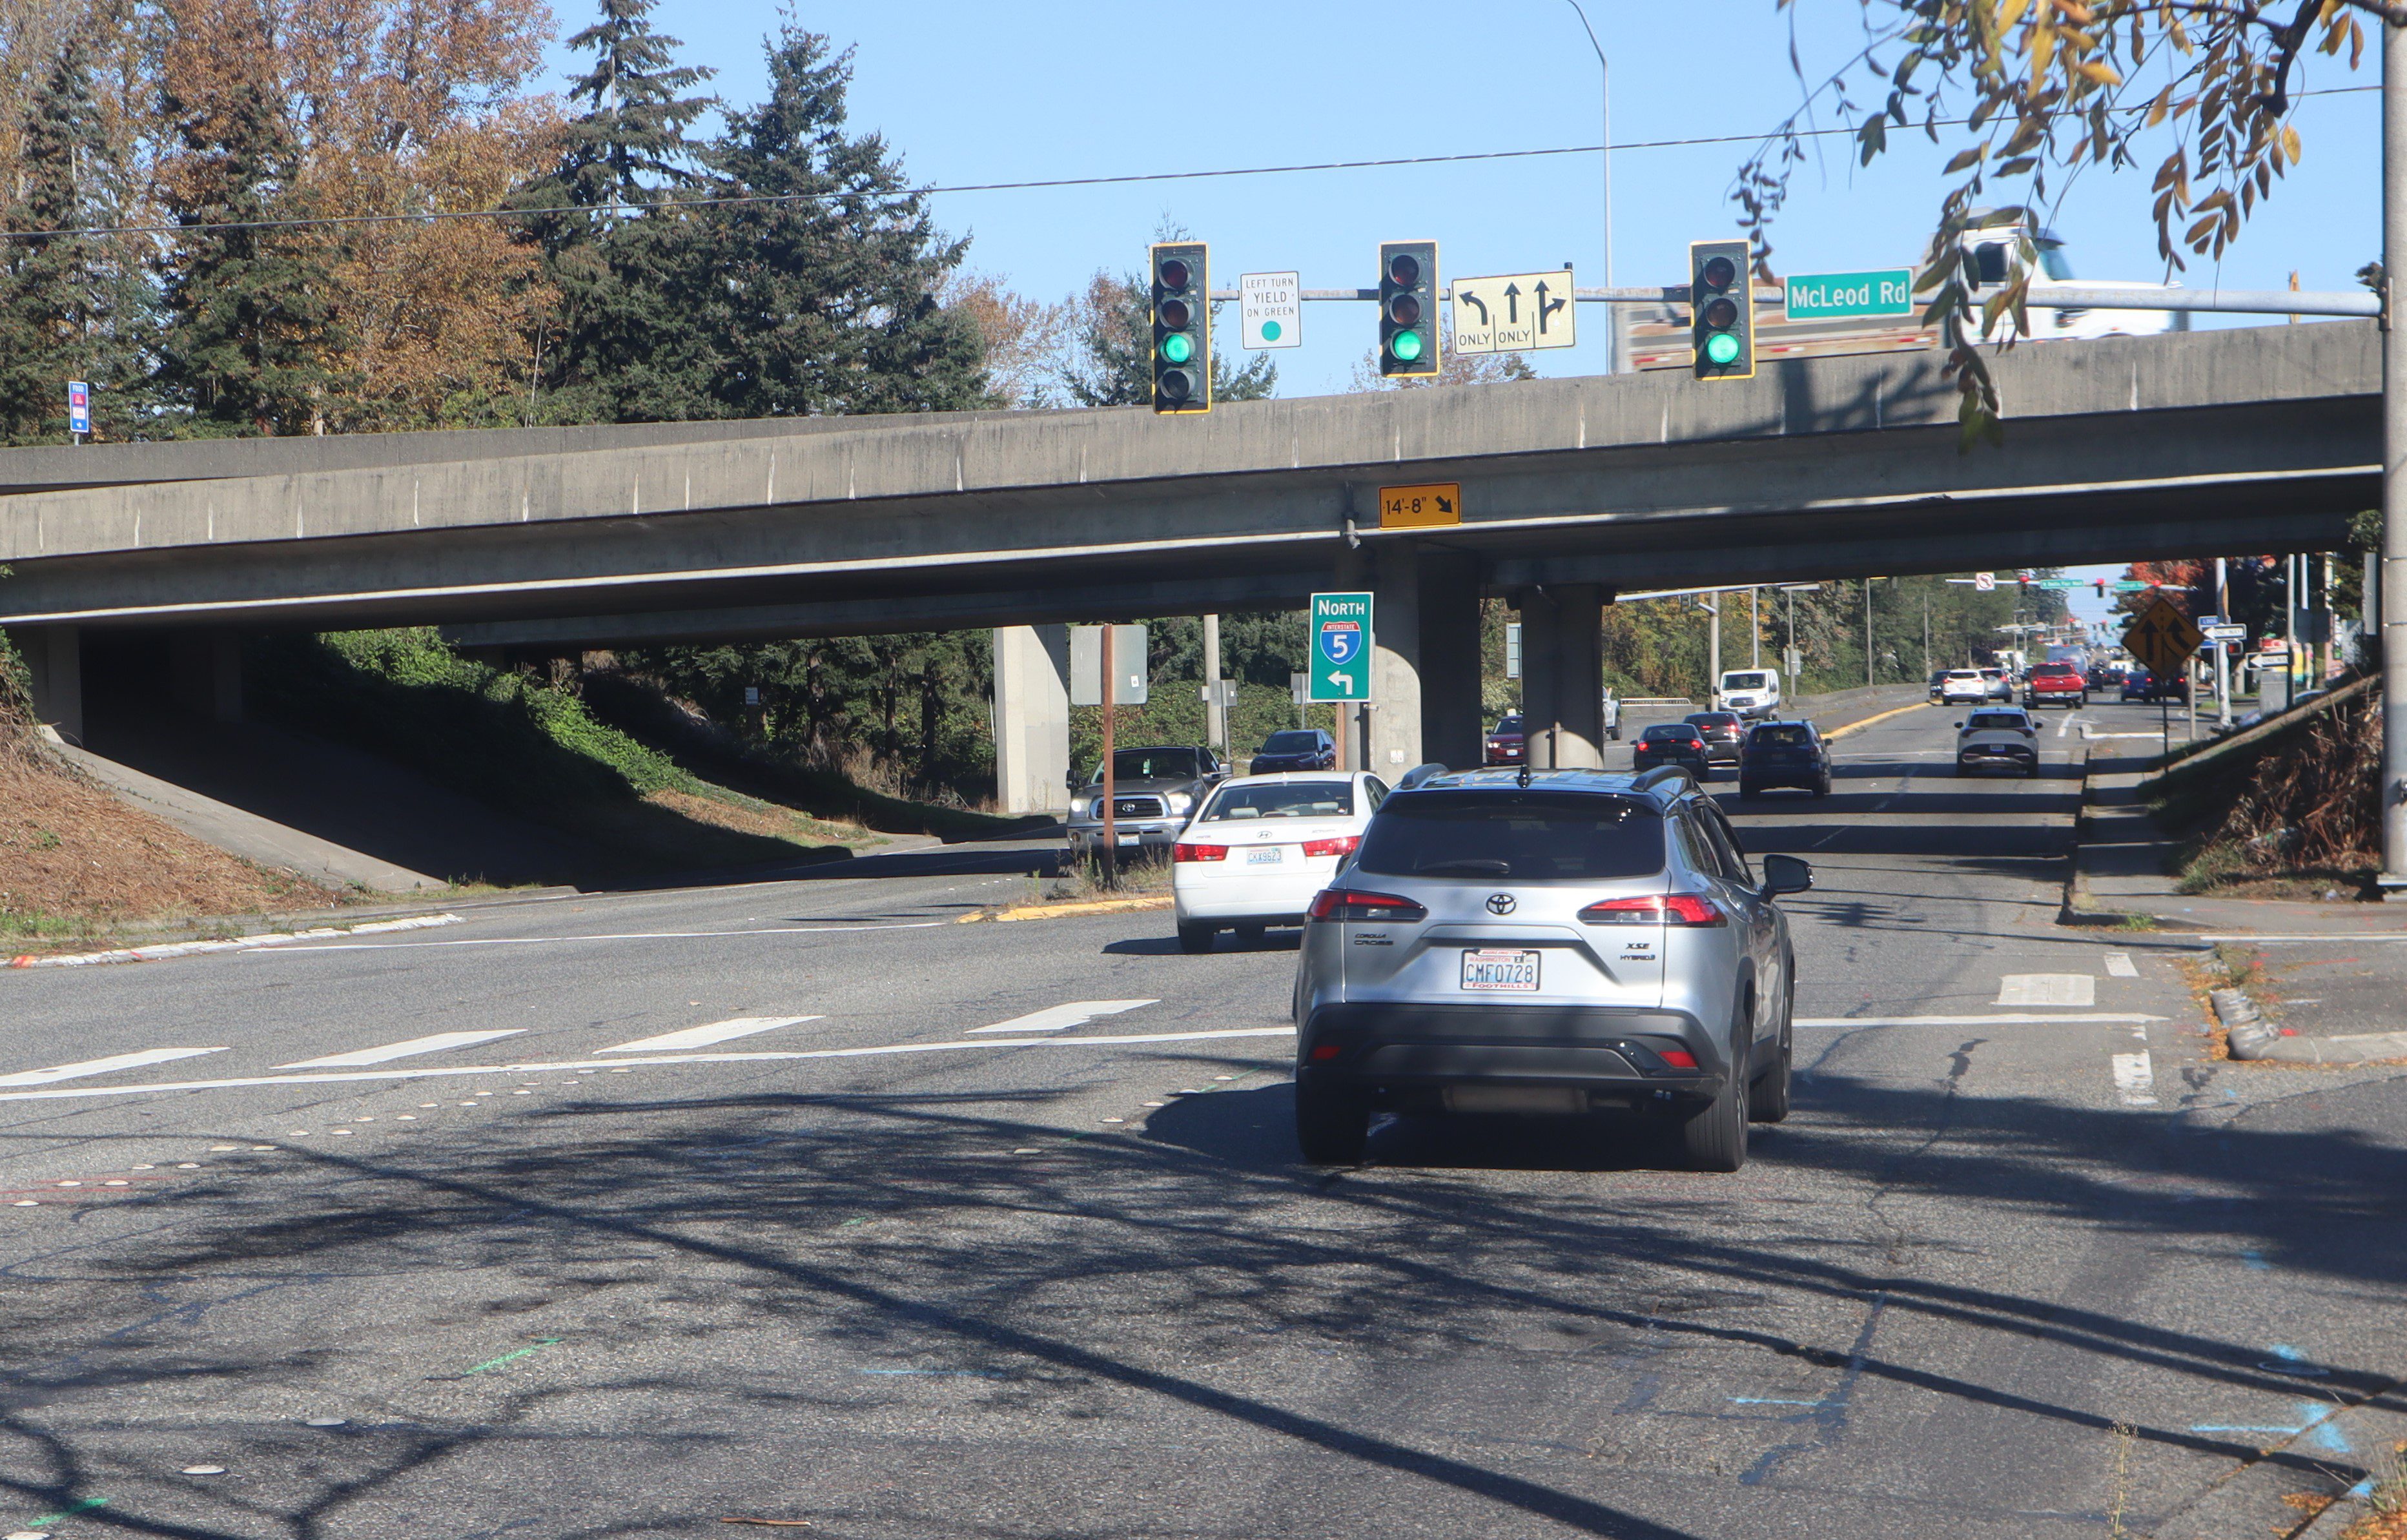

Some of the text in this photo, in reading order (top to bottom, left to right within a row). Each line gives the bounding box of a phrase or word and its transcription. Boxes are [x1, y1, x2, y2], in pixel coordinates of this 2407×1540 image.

[1246, 278, 1293, 288] LEFT TURN
[1254, 291, 1287, 303] YIELD
[1792, 281, 1906, 308] McLeod Rd
[1247, 307, 1294, 317] ON GREEN
[1459, 333, 1490, 345] ONLY
[1499, 330, 1530, 343] ONLY
[1318, 599, 1365, 616] NORTH
[1333, 634, 1348, 658] 5
[1466, 963, 1533, 983] CMF0728
